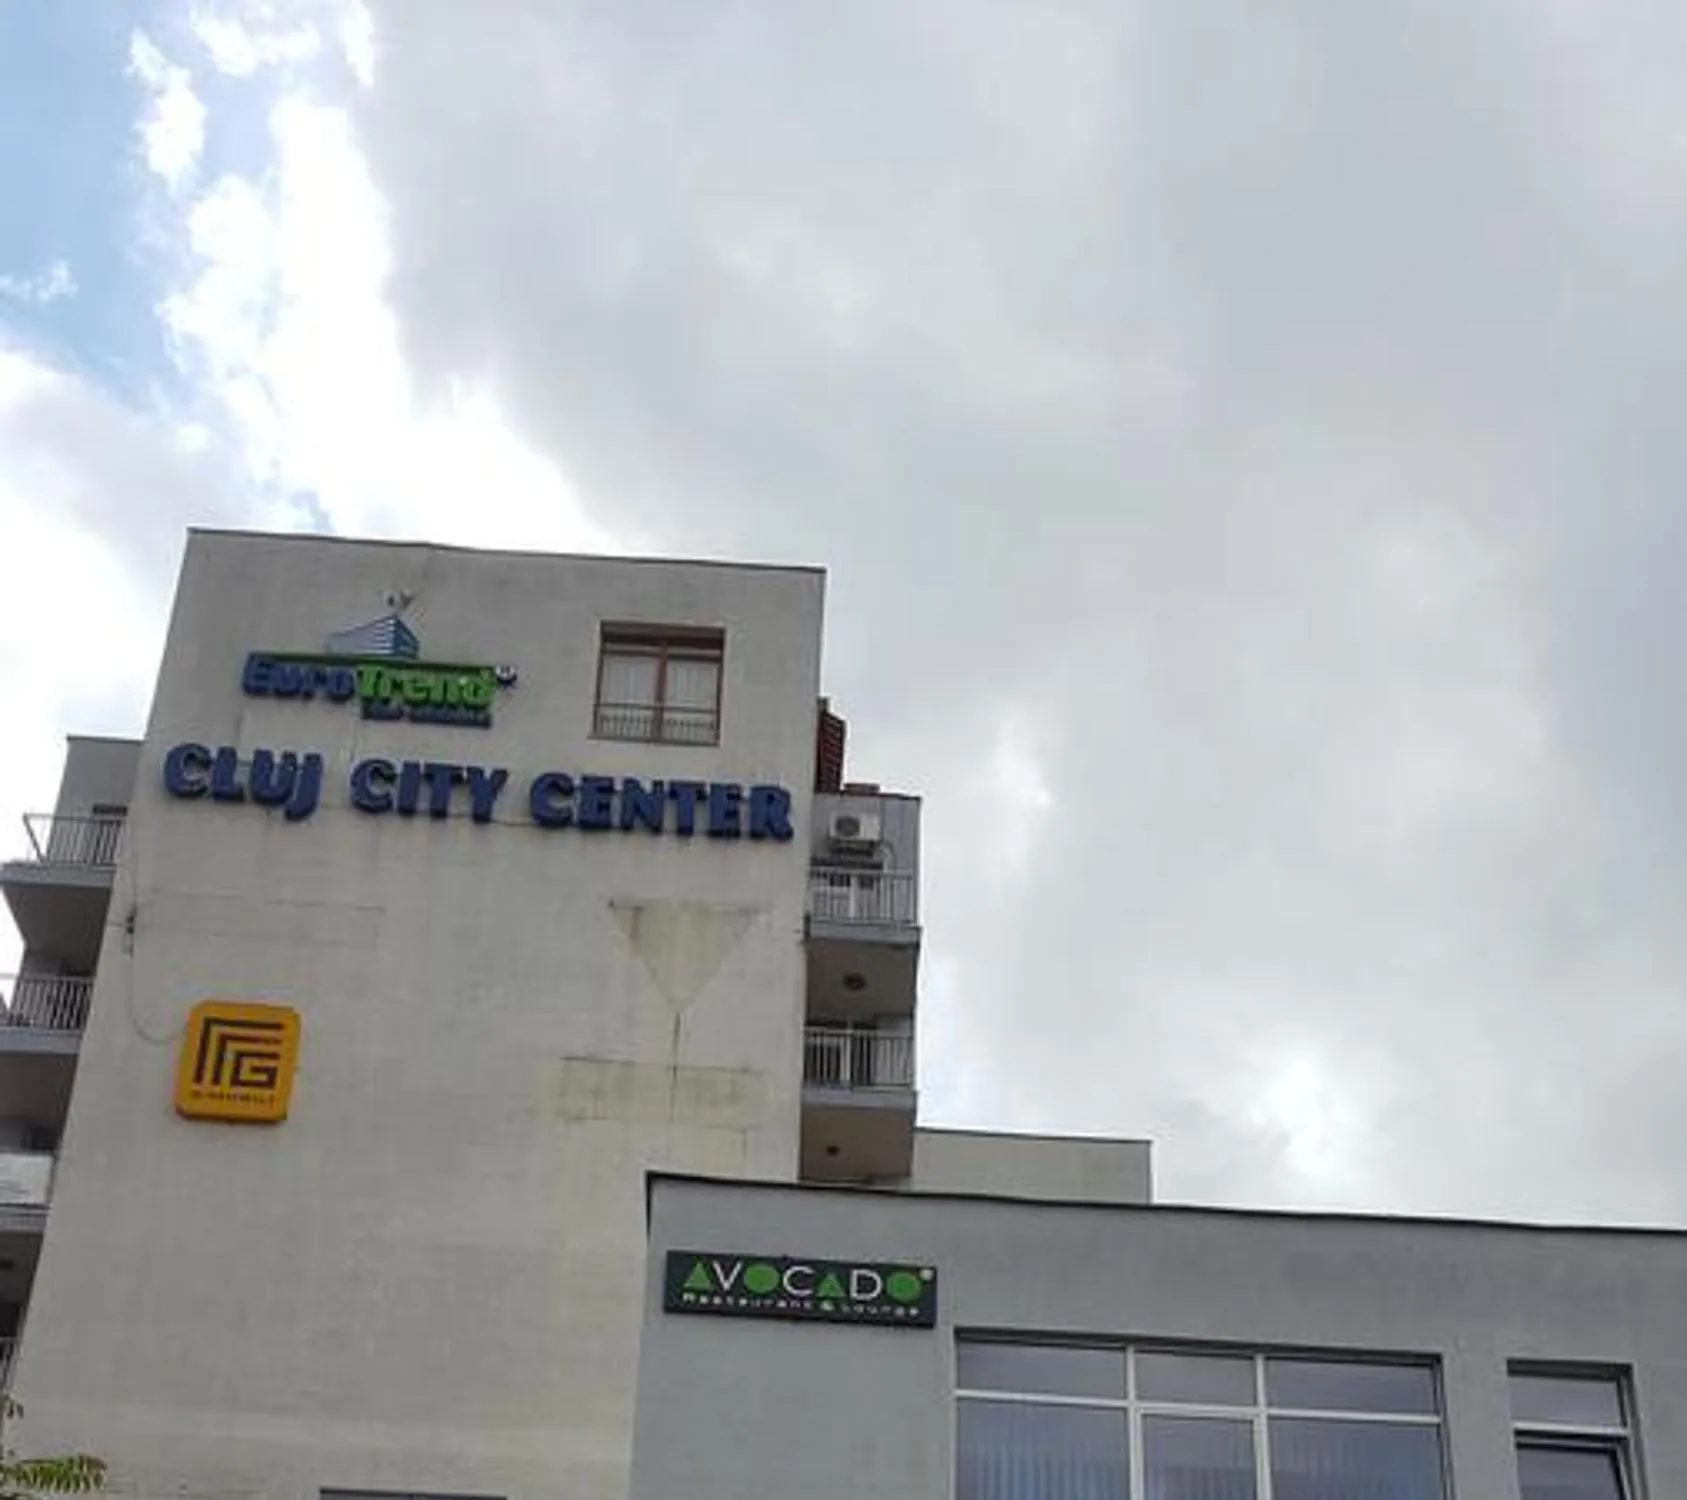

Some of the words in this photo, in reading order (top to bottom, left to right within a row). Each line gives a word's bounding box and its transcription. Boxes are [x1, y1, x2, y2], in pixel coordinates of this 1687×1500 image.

[163, 743, 322, 822] CLUJ
[350, 758, 507, 825] CITY
[529, 771, 795, 842] CENTER
[683, 1259, 922, 1302] AVOCADO
